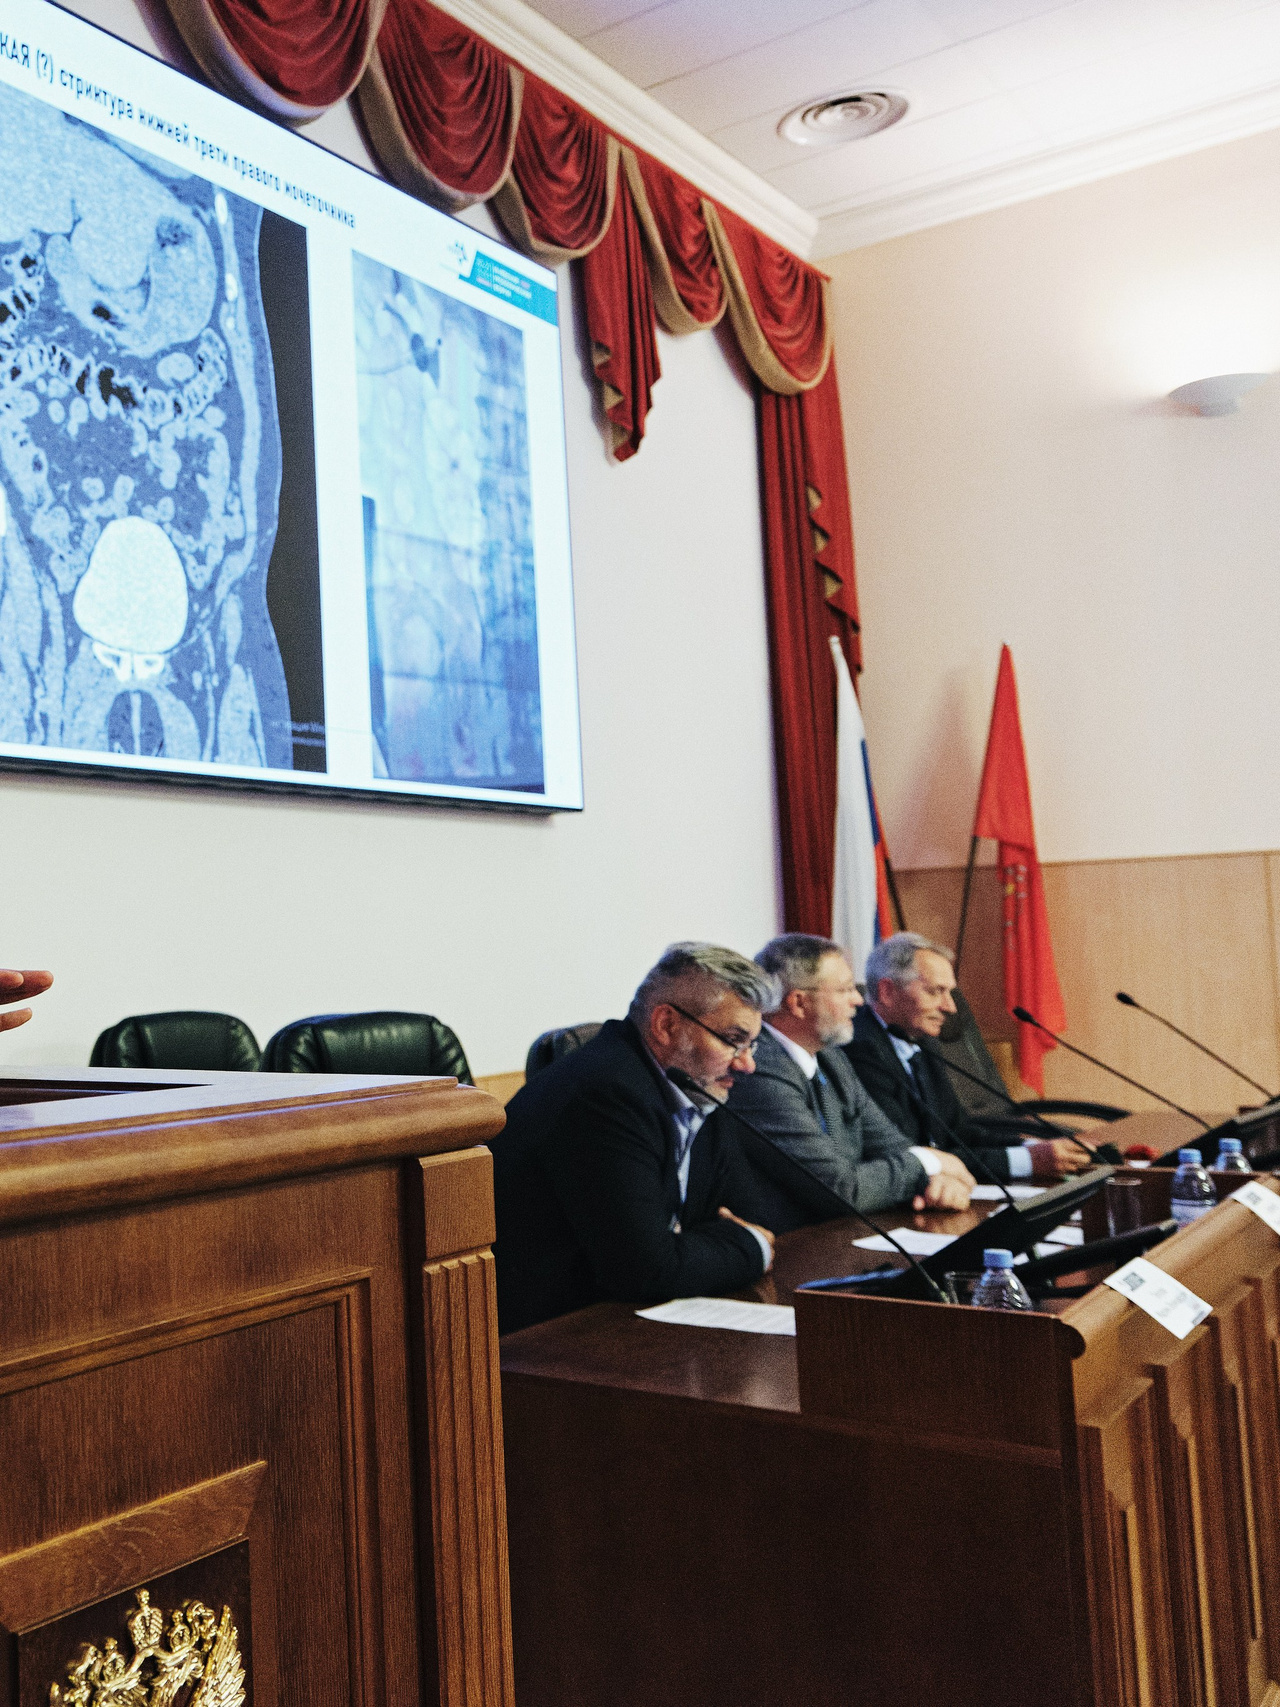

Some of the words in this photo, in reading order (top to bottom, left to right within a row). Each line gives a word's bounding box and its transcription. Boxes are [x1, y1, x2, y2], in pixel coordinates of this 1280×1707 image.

[36, 49, 54, 84] (?)
[60, 69, 133, 119] стриктура
[138, 107, 190, 146] нижней
[194, 136, 229, 167] трети
[233, 156, 280, 192] правого
[285, 181, 356, 228] мочеточника
